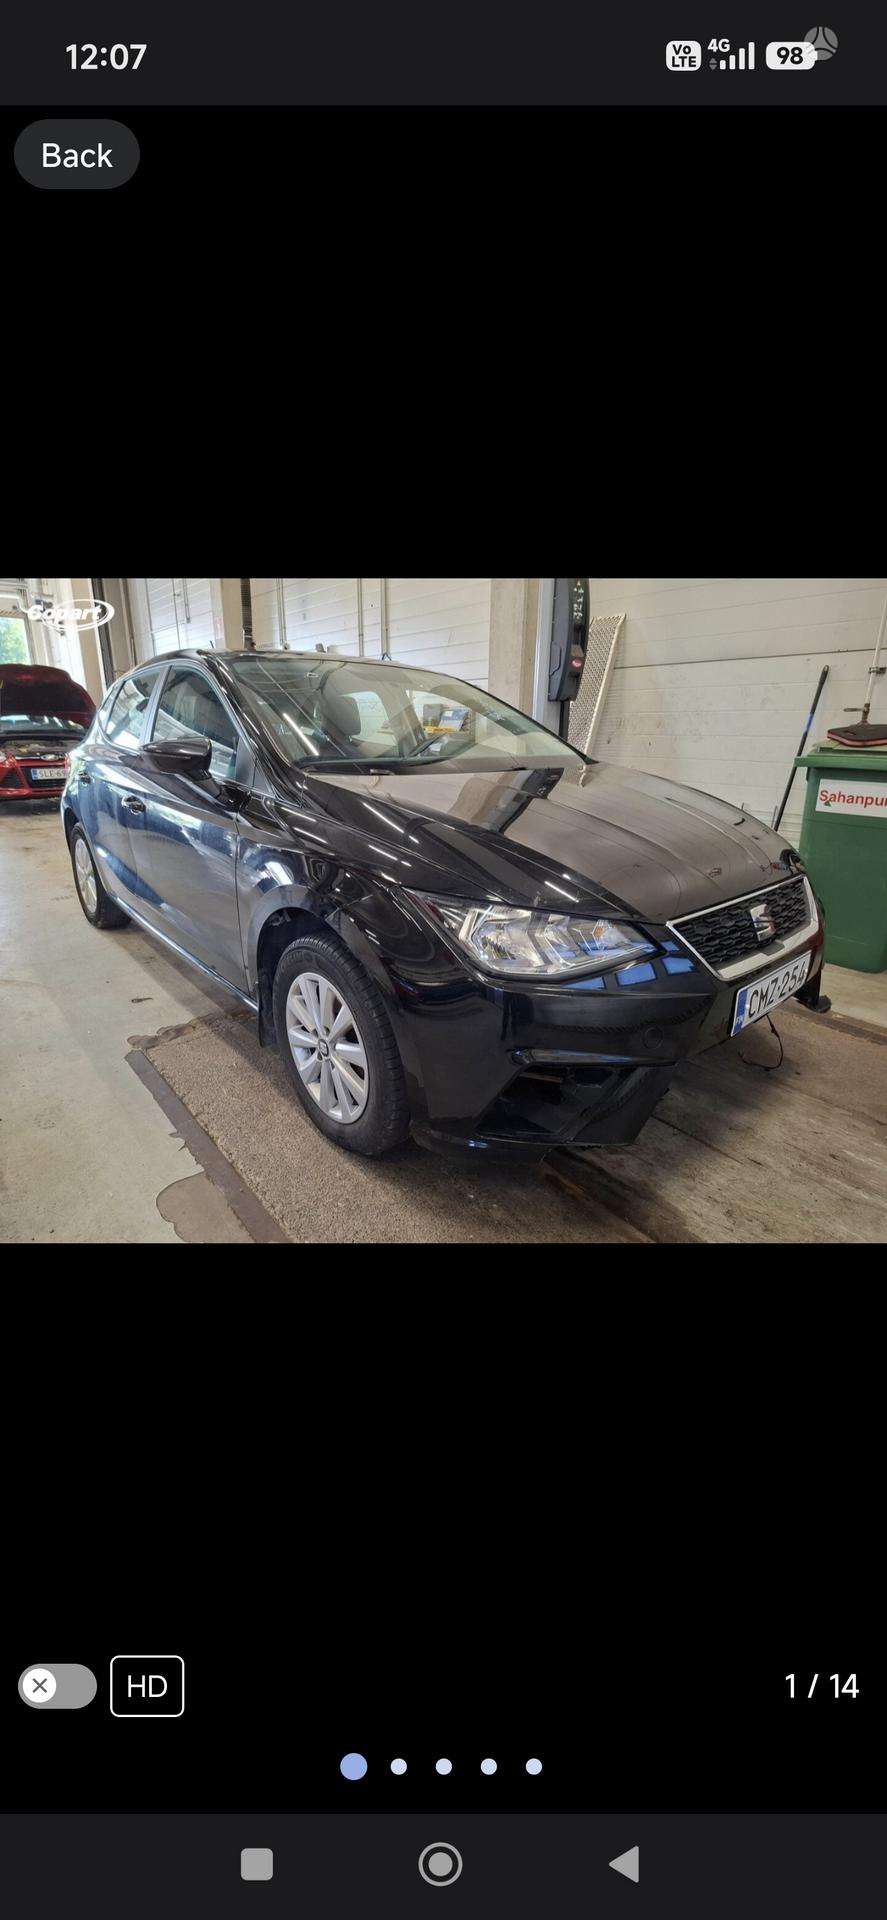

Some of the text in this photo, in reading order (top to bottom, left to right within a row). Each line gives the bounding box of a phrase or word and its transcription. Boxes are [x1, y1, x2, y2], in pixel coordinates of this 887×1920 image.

[672, 44, 692, 56] Vo
[707, 38, 731, 53] 4G
[776, 46, 804, 65] 98
[65, 43, 148, 70] 12:07
[671, 56, 697, 68] LTE
[42, 142, 114, 169] Back
[127, 1674, 168, 1698] HD
[785, 1673, 860, 1699] 1 / 14
